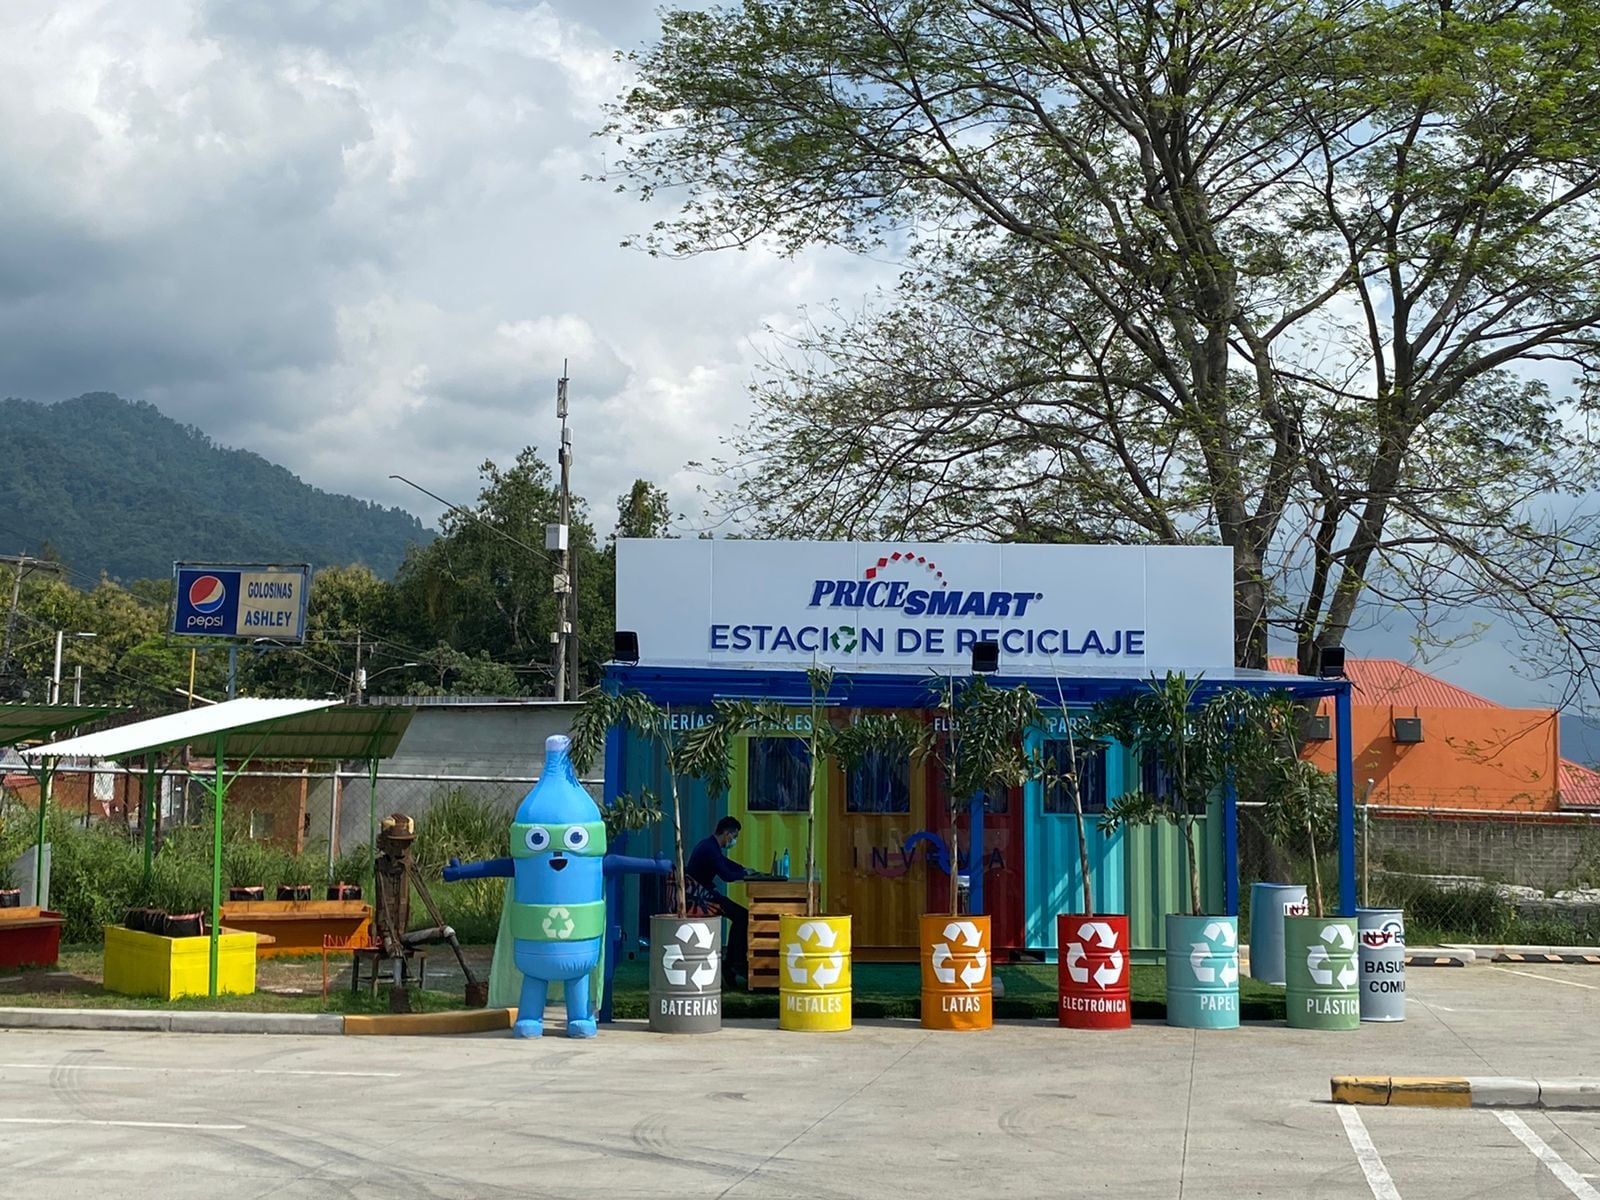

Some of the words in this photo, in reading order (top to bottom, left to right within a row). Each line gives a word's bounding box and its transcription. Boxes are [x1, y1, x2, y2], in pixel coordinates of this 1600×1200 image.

[248, 582, 292, 599] GOLOSINAS
[187, 614, 223, 628] pepsi
[244, 610, 292, 626] ASHLEY
[897, 628, 944, 653] DE
[661, 997, 718, 1016] BATERÍAS
[786, 996, 842, 1012] METALES
[942, 996, 981, 1012] LATAS
[1062, 996, 1127, 1013] ELECTRÓNICA
[1200, 995, 1236, 1011] PAPEL
